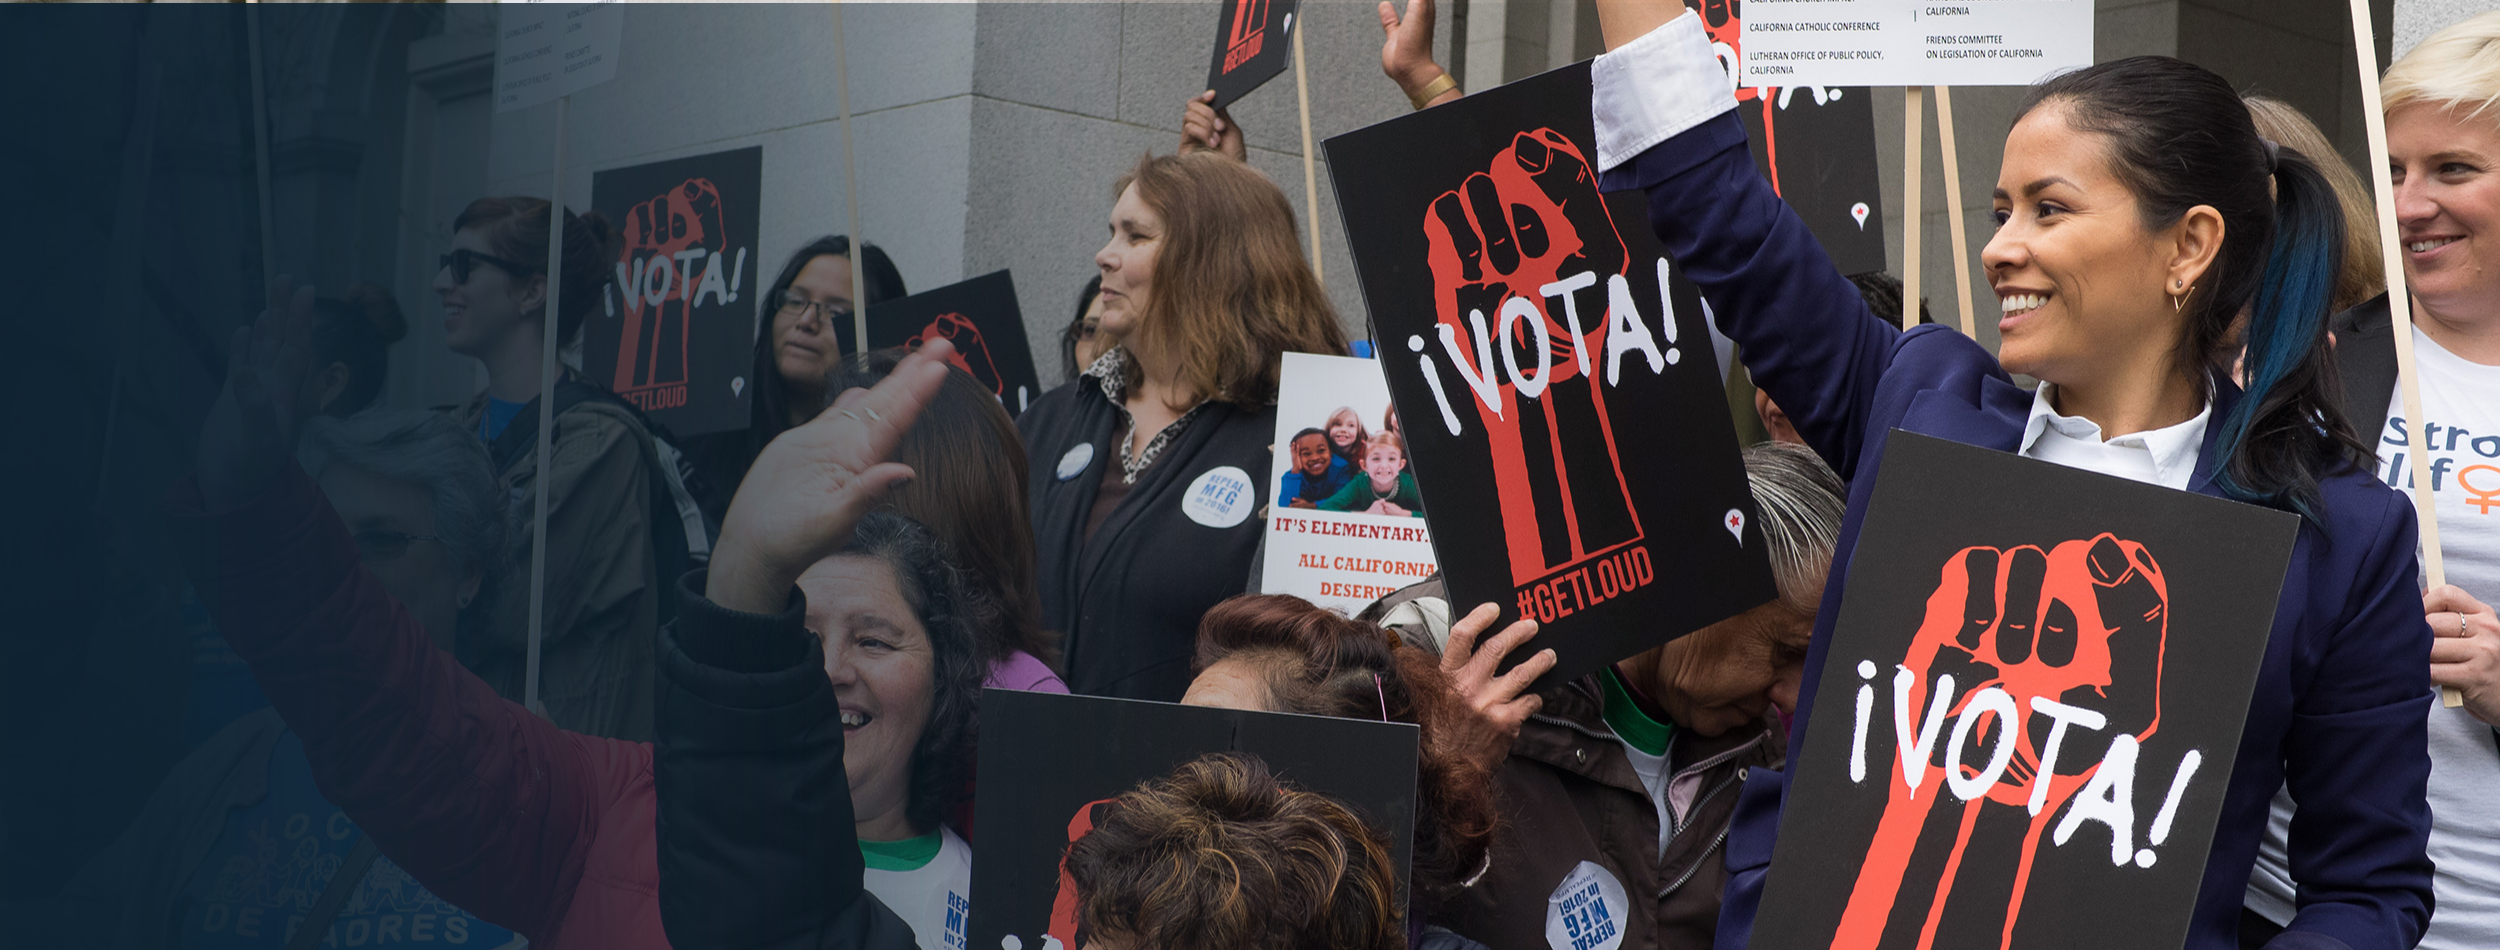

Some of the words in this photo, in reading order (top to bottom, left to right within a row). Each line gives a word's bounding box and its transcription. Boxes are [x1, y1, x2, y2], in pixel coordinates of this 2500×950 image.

[1926, 7, 1970, 16] CALIFORNIA
[1749, 23, 1793, 32] CALIFORNIA
[1795, 22, 1831, 31] CATHOLIC
[1832, 22, 1880, 31] CONFERENCE
[1926, 35, 1957, 44] FRIENDS
[1958, 35, 2003, 44] COMMITTEE
[1750, 52, 1789, 60] LUTHERAN
[1791, 51, 1815, 60] OFFICE
[1817, 51, 1827, 60] OF
[1829, 51, 1855, 59] PUBLIC
[1856, 51, 1884, 60] POLICY,
[1926, 50, 1938, 58] ON
[1939, 50, 1986, 58] LEGISLATION
[1988, 50, 1998, 58] OF
[1999, 49, 2043, 58] CALIFORNIA
[1750, 66, 1794, 75] CALIFORNIA
[1408, 257, 1681, 437] ¡VOTA!
[1200, 483, 1238, 506] MFG
[1209, 474, 1244, 493] REPEAL
[1310, 520, 1432, 543] ELEMENTARY.
[1298, 553, 1329, 569] ALL
[1333, 556, 1436, 578] CALIFORNIA
[1517, 545, 1654, 624] #GETLOUD
[1849, 659, 2201, 869] ¡VOTA!
[203, 903, 265, 938] DE
[1563, 896, 1610, 939] MFG
